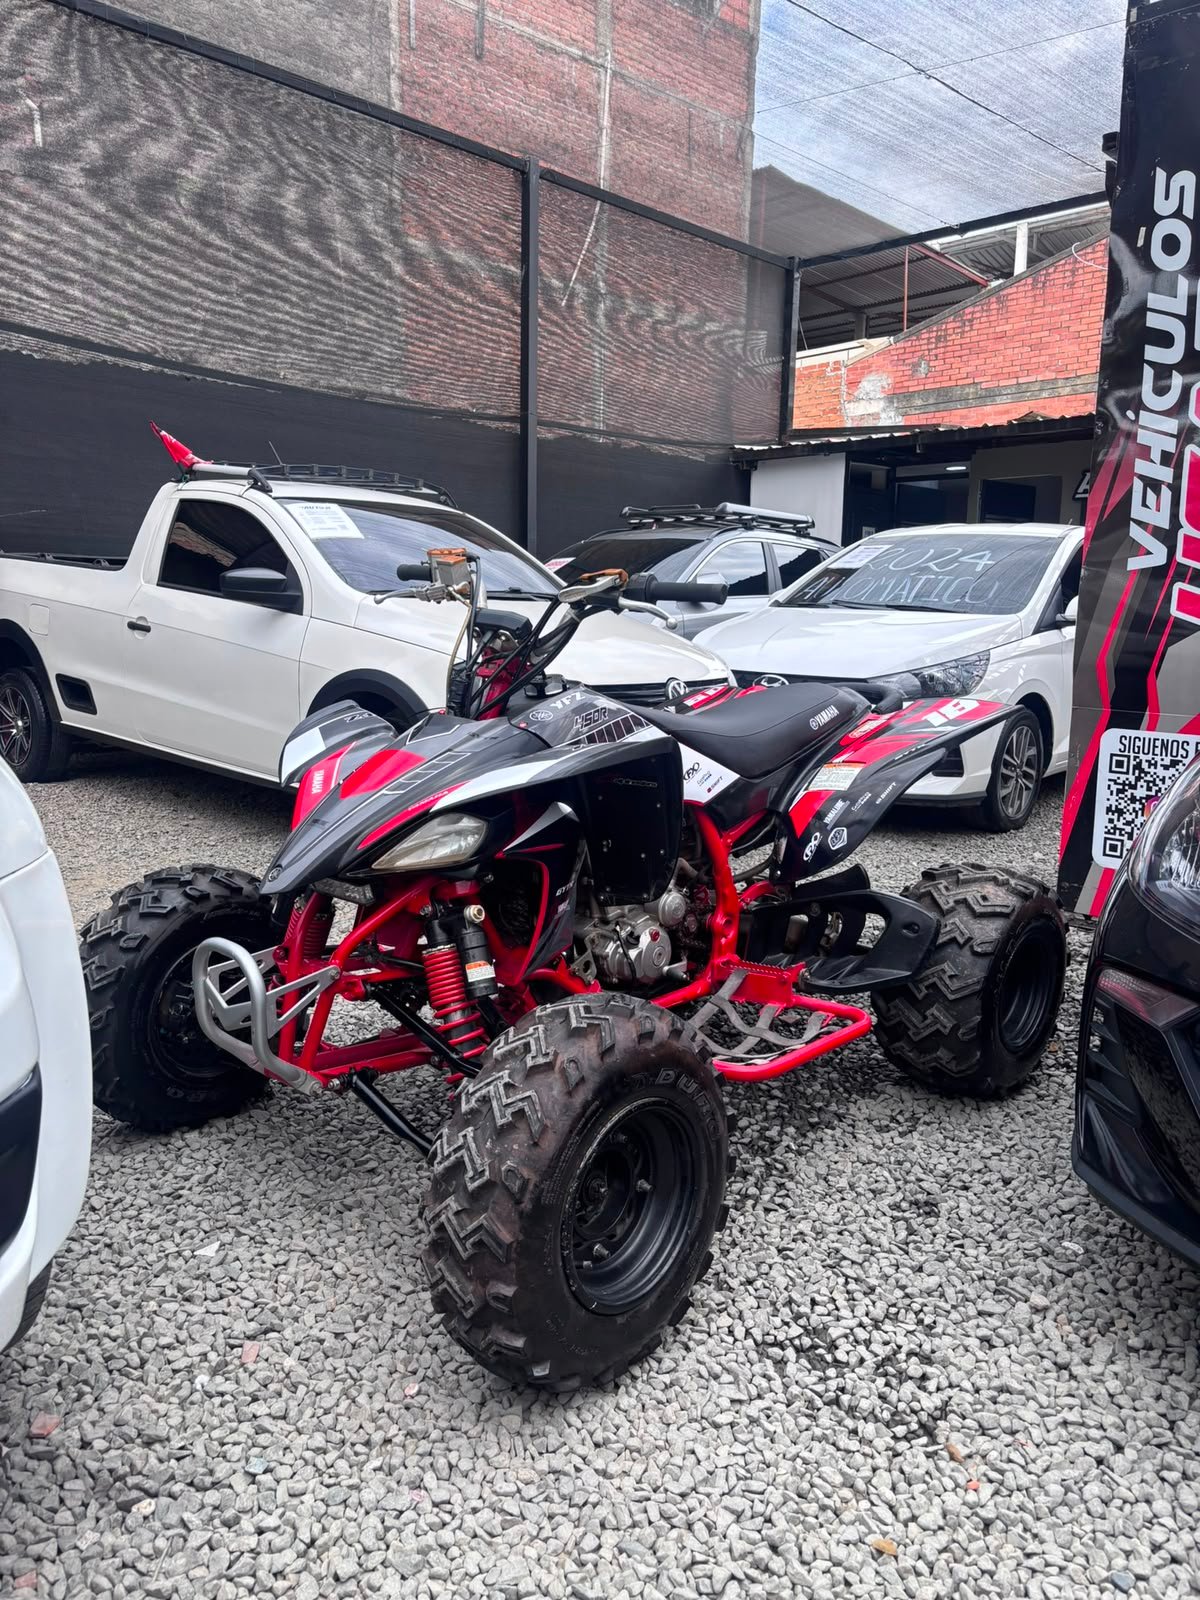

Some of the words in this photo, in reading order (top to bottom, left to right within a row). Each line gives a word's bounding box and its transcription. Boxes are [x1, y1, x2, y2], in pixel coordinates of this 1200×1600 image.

[867, 547, 996, 572] 2024
[549, 692, 586, 709] YFZ
[574, 705, 609, 731] 450R
[816, 705, 840, 728] YAMAHA
[921, 699, 980, 727] 18
[1118, 735, 1190, 759] SIGUENOS
